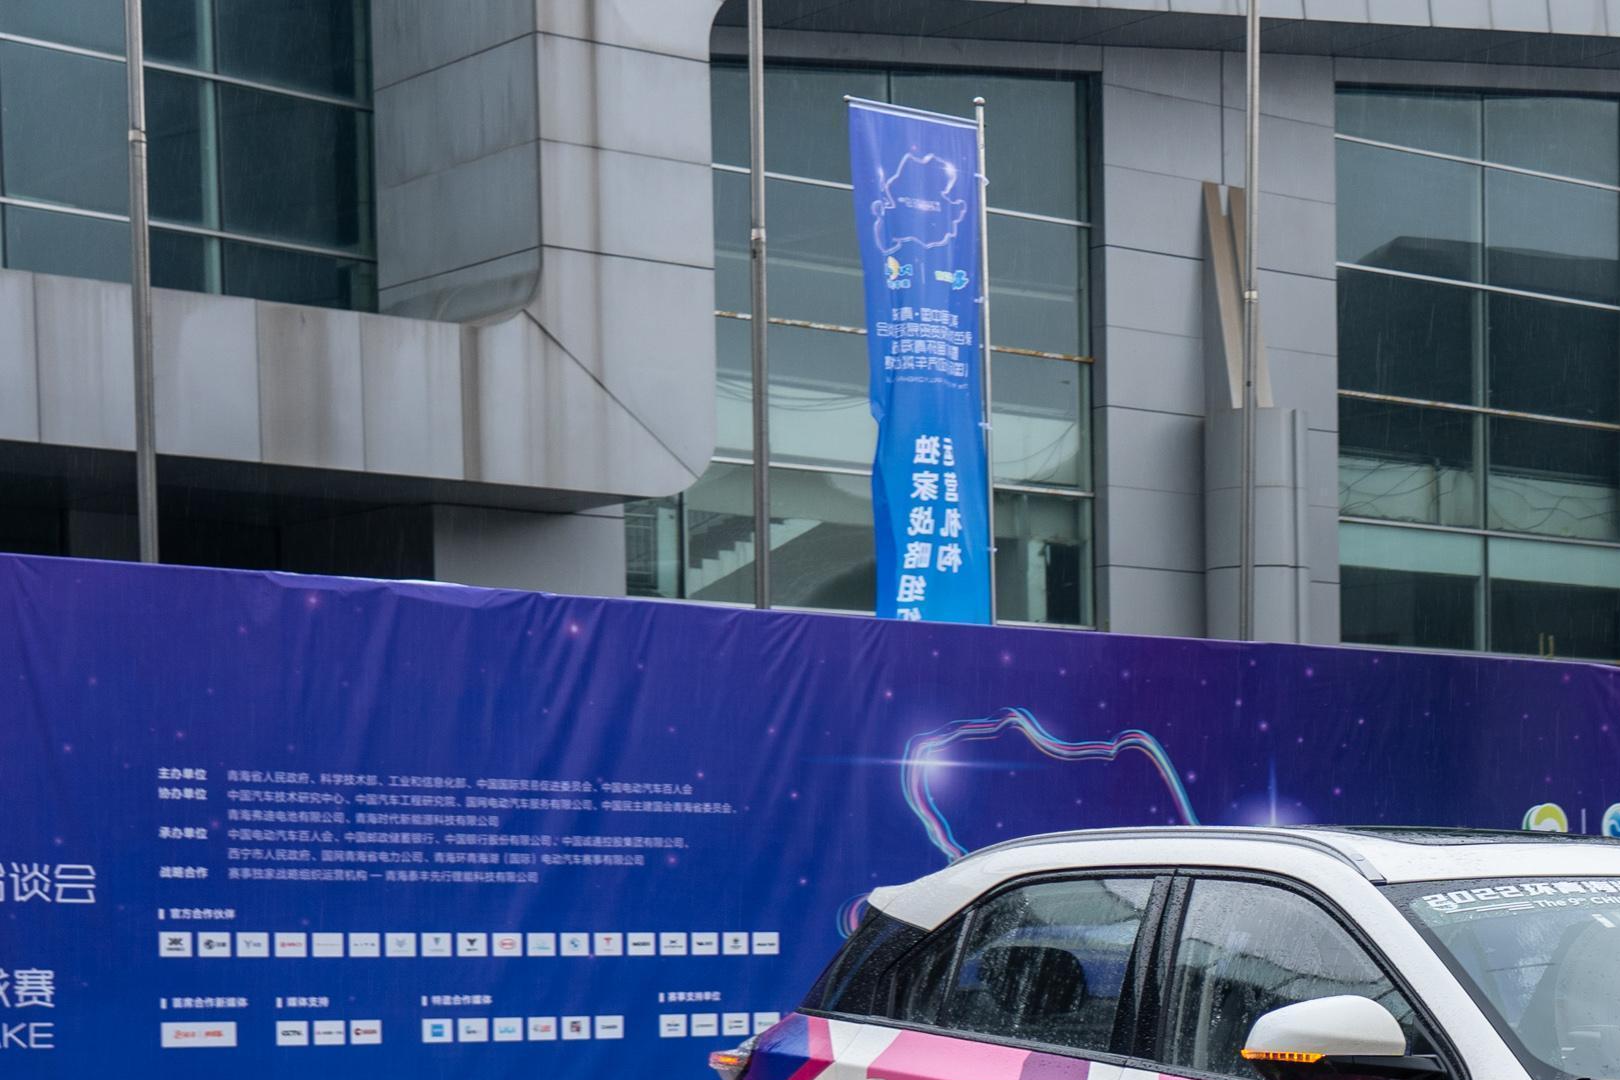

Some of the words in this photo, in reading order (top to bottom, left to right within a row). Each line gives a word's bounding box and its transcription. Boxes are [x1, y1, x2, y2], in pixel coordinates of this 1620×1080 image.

[158, 767, 208, 781] 主办单位
[0, 862, 96, 903] 谈会
[1531, 899, 1567, 908] The
[0, 968, 56, 1008] 赛
[0, 1022, 55, 1049] KE
